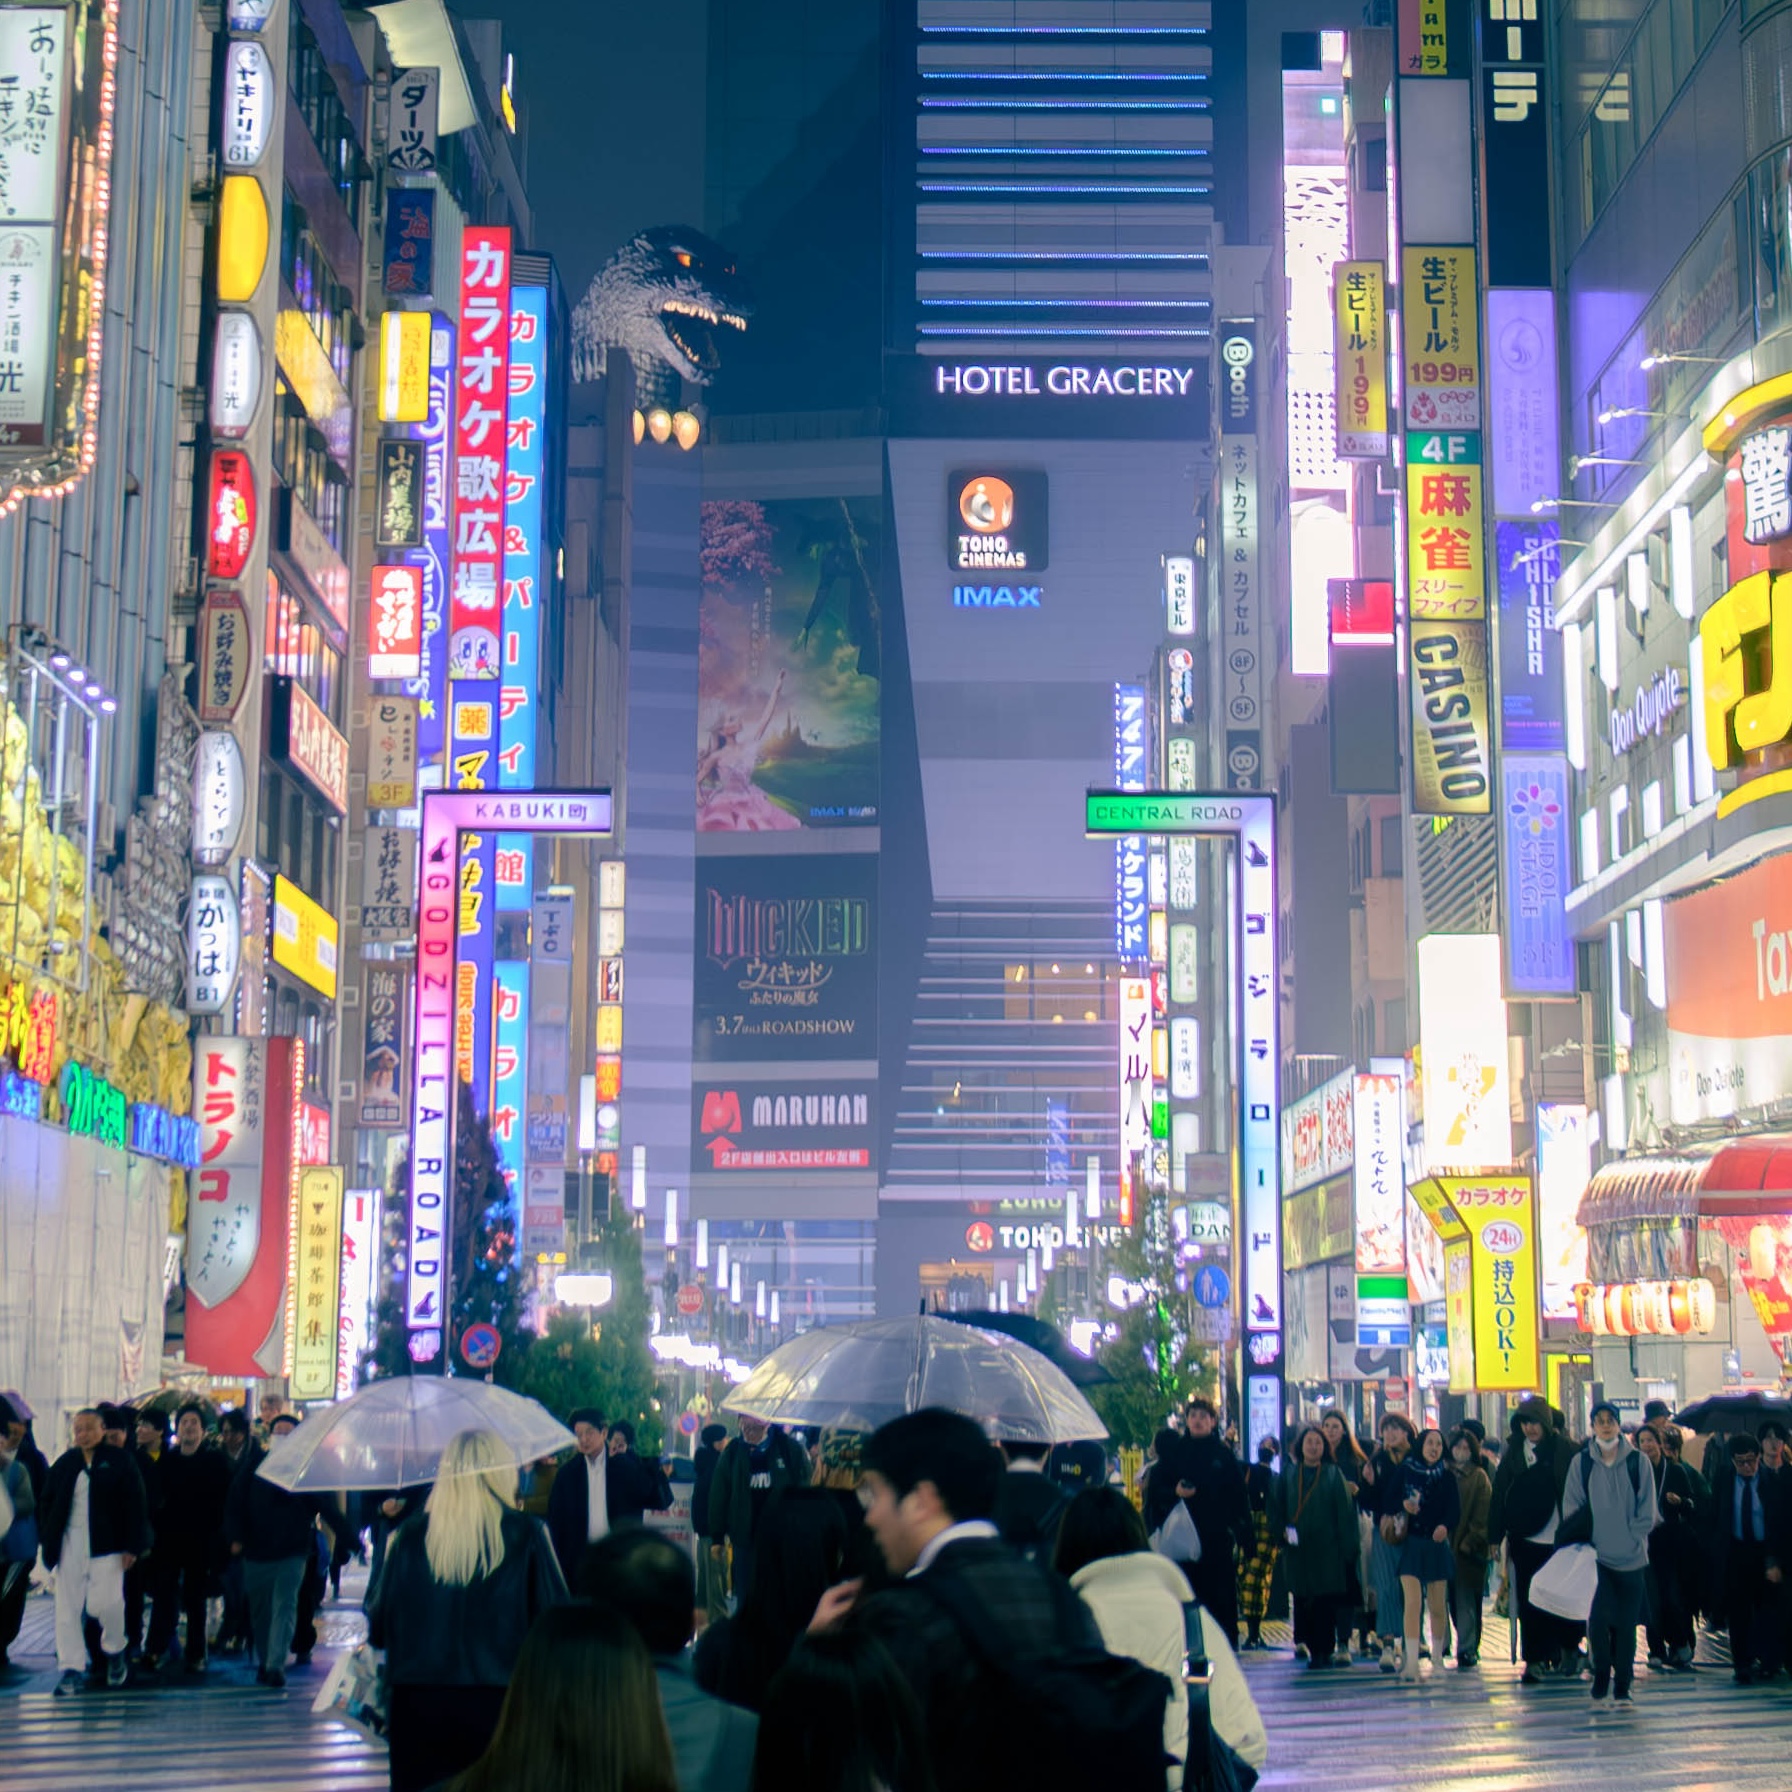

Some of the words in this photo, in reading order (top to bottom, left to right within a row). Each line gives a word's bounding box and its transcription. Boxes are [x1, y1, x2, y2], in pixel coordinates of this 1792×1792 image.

[402, 86, 426, 150] ダーツ
[386, 207, 429, 291] 海の家
[1346, 272, 1368, 350] 生ビール
[1422, 257, 1448, 352] 生ビール
[937, 366, 1040, 395] HOTEL
[1047, 366, 1194, 395] GRACERY
[1411, 362, 1474, 382] 199円
[455, 240, 504, 610] カラオケ歌広場
[1421, 436, 1466, 462] 4F
[958, 536, 1008, 552] TOHO
[1419, 473, 1472, 571] 麻雀
[958, 553, 1026, 568] CINEMAS
[953, 586, 1042, 608] IMAX
[1414, 579, 1464, 594] スリー
[214, 612, 236, 706] お好み焼き
[1235, 656, 1250, 667] 8F
[457, 706, 490, 736] 薬
[1235, 702, 1250, 714] 5F
[1414, 634, 1487, 799] CASINO
[1611, 707, 1635, 757] Don
[1635, 664, 1680, 737] Quijote
[380, 783, 402, 801] 3F
[476, 803, 587, 821] KABUKI町
[1096, 806, 1184, 820] CENTRAL
[1191, 806, 1243, 820] ROAD
[1521, 840, 1539, 917] STAGE
[1539, 841, 1556, 903] IDOL
[706, 888, 868, 970] WICKED
[197, 988, 219, 1000] B1
[370, 972, 397, 1042] 海の家
[419, 875, 451, 1125] GODZILLA
[715, 1015, 744, 1034] 3.7
[762, 1020, 855, 1034] ROADSHOW
[1245, 912, 1271, 1251] ゴジラロード
[199, 1053, 237, 1203] トラノコ
[753, 1094, 868, 1126] MARUHAN
[414, 1157, 442, 1278] ROAD
[1456, 1187, 1527, 1206] カラオケ
[1000, 1226, 1063, 1248] TOHO
[1493, 1259, 1516, 1372] 持込OK!
